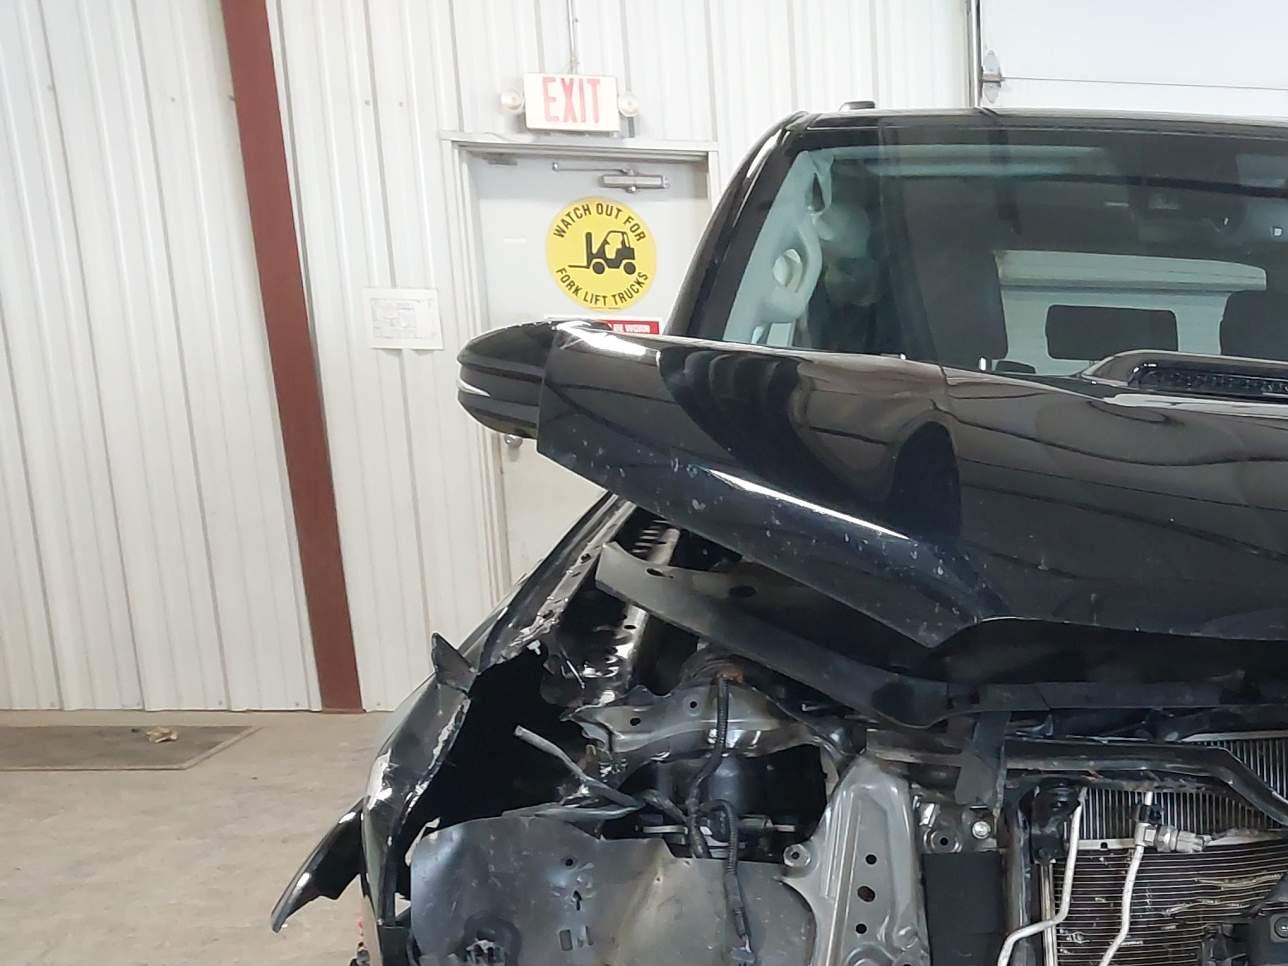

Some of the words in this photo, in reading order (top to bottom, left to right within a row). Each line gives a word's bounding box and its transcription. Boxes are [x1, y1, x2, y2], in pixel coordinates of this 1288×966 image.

[542, 77, 601, 124] EXIT
[553, 203, 592, 239] WATCH
[596, 202, 623, 220] OUT
[623, 215, 647, 242] FOR
[555, 267, 583, 297] FORK
[583, 291, 608, 307] LIFT
[611, 271, 649, 306] TRUCKS
